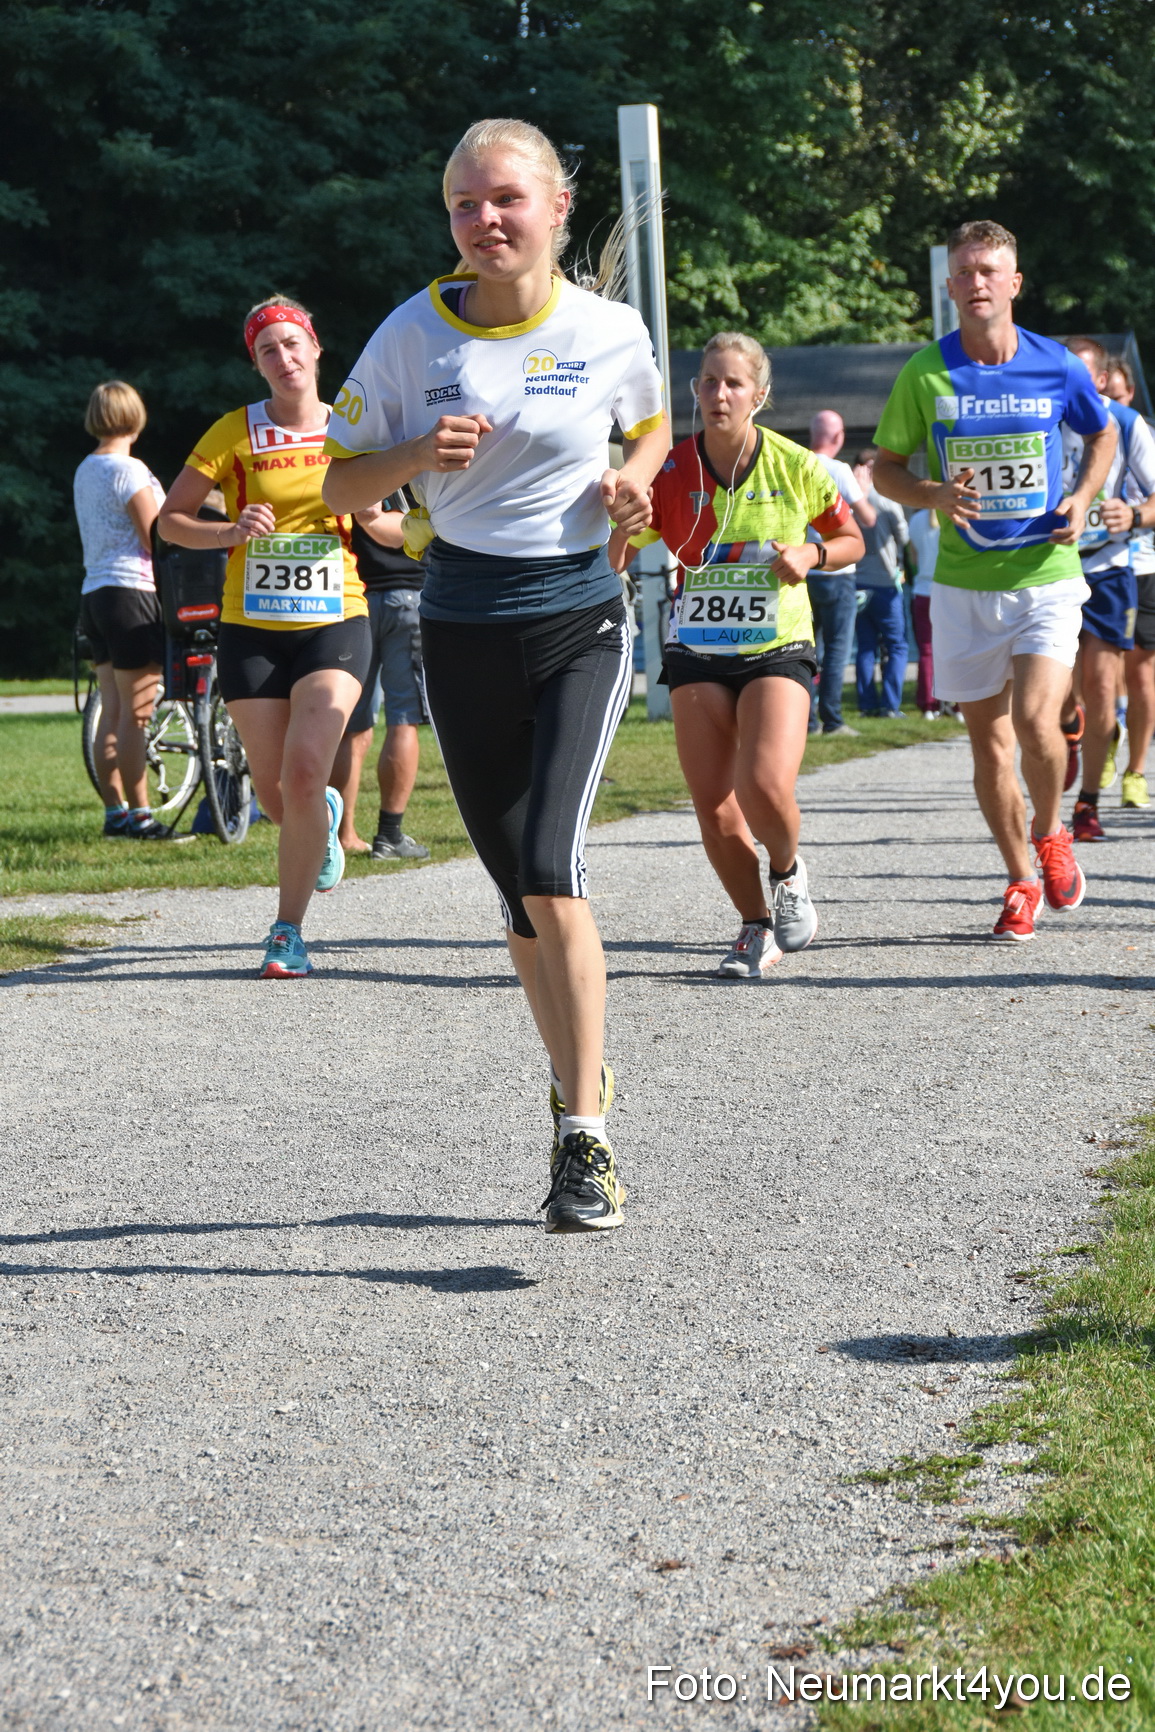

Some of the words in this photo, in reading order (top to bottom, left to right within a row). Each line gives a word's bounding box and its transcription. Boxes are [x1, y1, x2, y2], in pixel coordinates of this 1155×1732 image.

[527, 356, 555, 374] 20
[525, 373, 590, 384] Neumarkter
[524, 385, 578, 398] Stadtlauf
[333, 386, 363, 426] 20
[961, 394, 1052, 419] Freitag
[953, 439, 1036, 459] BOCK
[252, 457, 296, 473] MAX
[959, 464, 1035, 491] 2132
[981, 497, 1027, 510] IKTOR
[253, 538, 334, 557] BOCK
[255, 564, 329, 591] 2381
[691, 568, 771, 588] BOCK
[689, 596, 766, 622] 2845
[702, 629, 766, 643] LAURA
